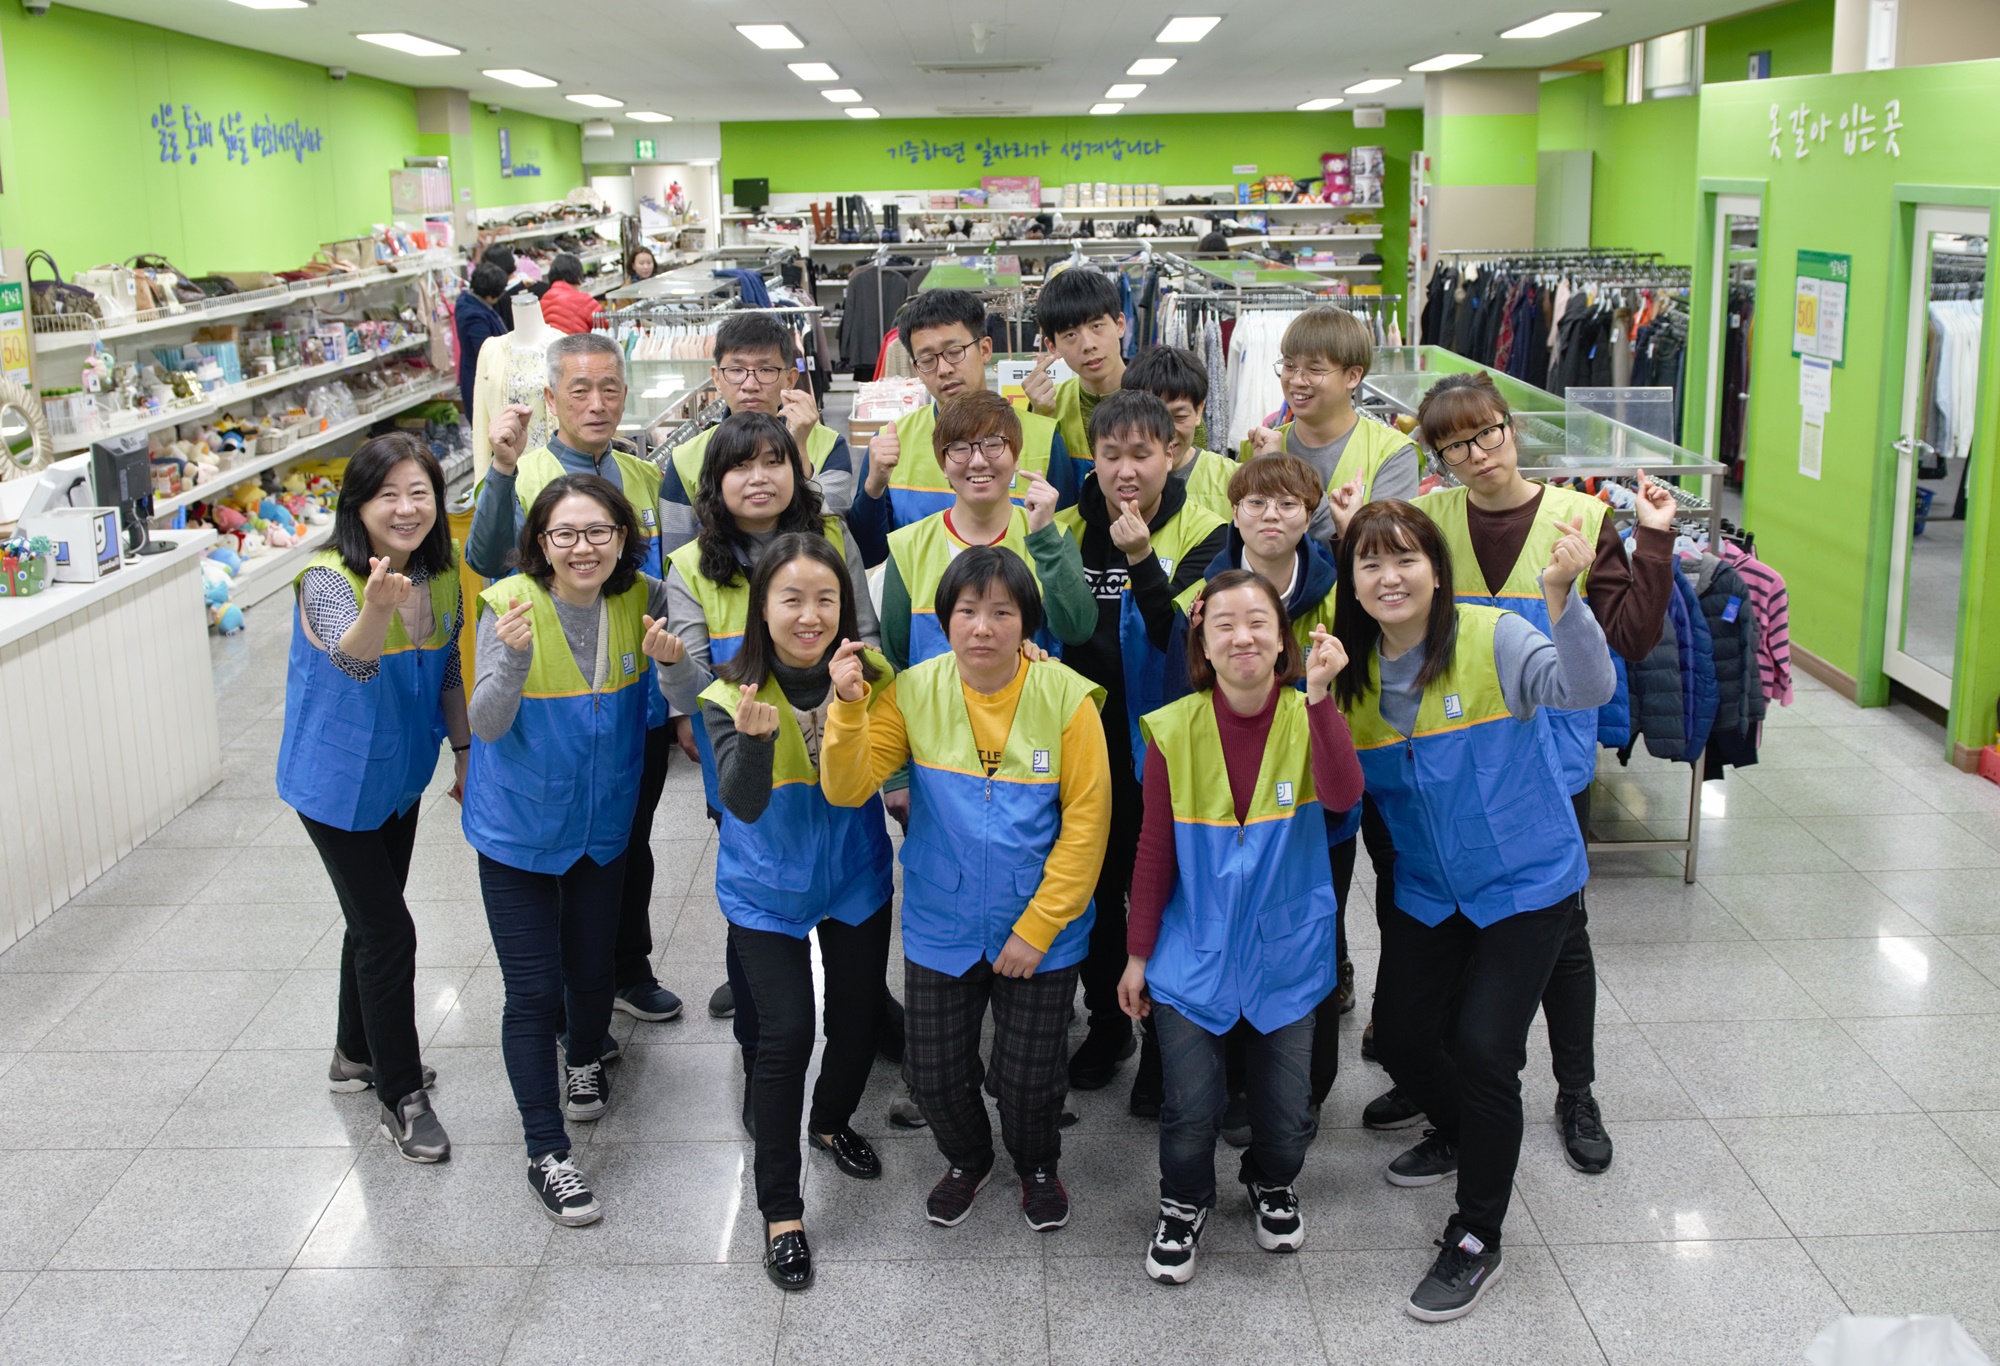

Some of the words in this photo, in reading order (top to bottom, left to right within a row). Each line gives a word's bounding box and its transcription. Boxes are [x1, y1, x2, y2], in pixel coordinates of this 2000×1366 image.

[151, 103, 182, 162] 일을
[182, 105, 213, 165] 통해
[219, 111, 249, 164] 삶을
[887, 139, 965, 164] 기증하면
[975, 137, 1050, 167] 일자리가
[1060, 137, 1166, 161] 생겨납니다
[1768, 103, 1782, 159] 옷
[1789, 102, 1833, 159] 갈아
[1839, 102, 1876, 156] 입는
[1883, 99, 1904, 158] 곳
